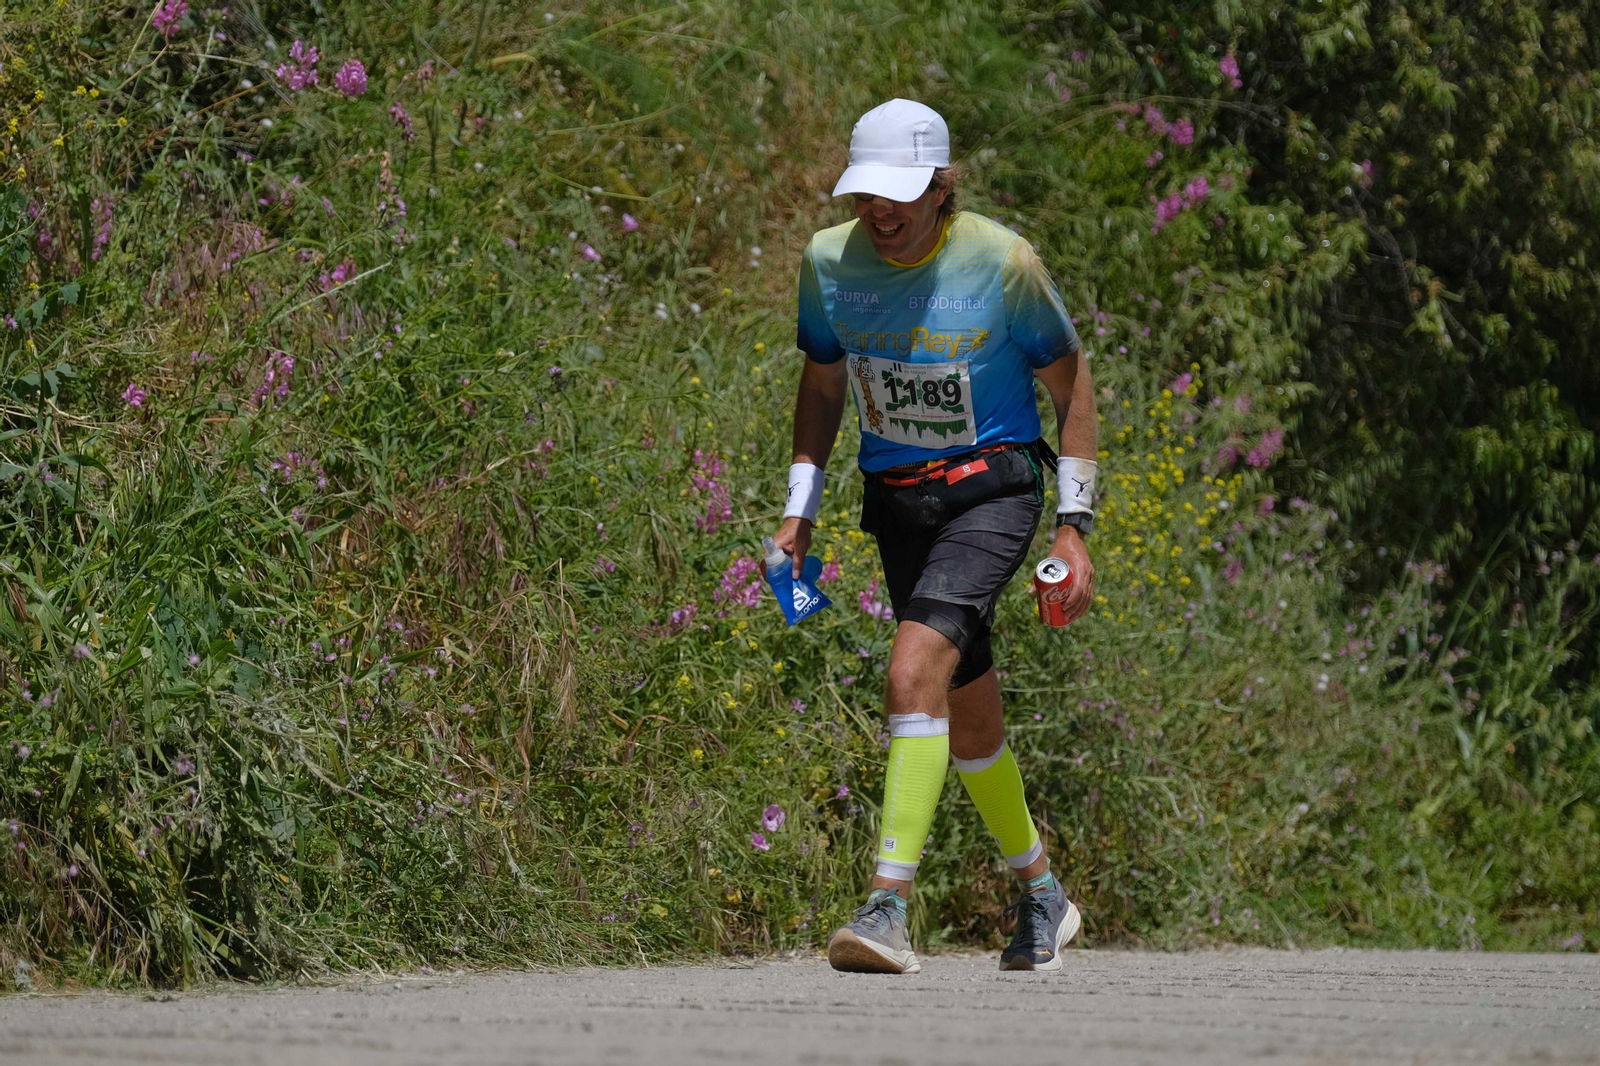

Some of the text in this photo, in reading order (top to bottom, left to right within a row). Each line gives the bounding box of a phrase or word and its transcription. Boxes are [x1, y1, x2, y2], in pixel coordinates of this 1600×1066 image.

[835, 290, 880, 305] CURVA
[908, 296, 986, 314] BTODigital
[852, 306, 892, 315] ingenieros
[835, 321, 962, 359] TrainingRey
[883, 376, 963, 408] 1189
